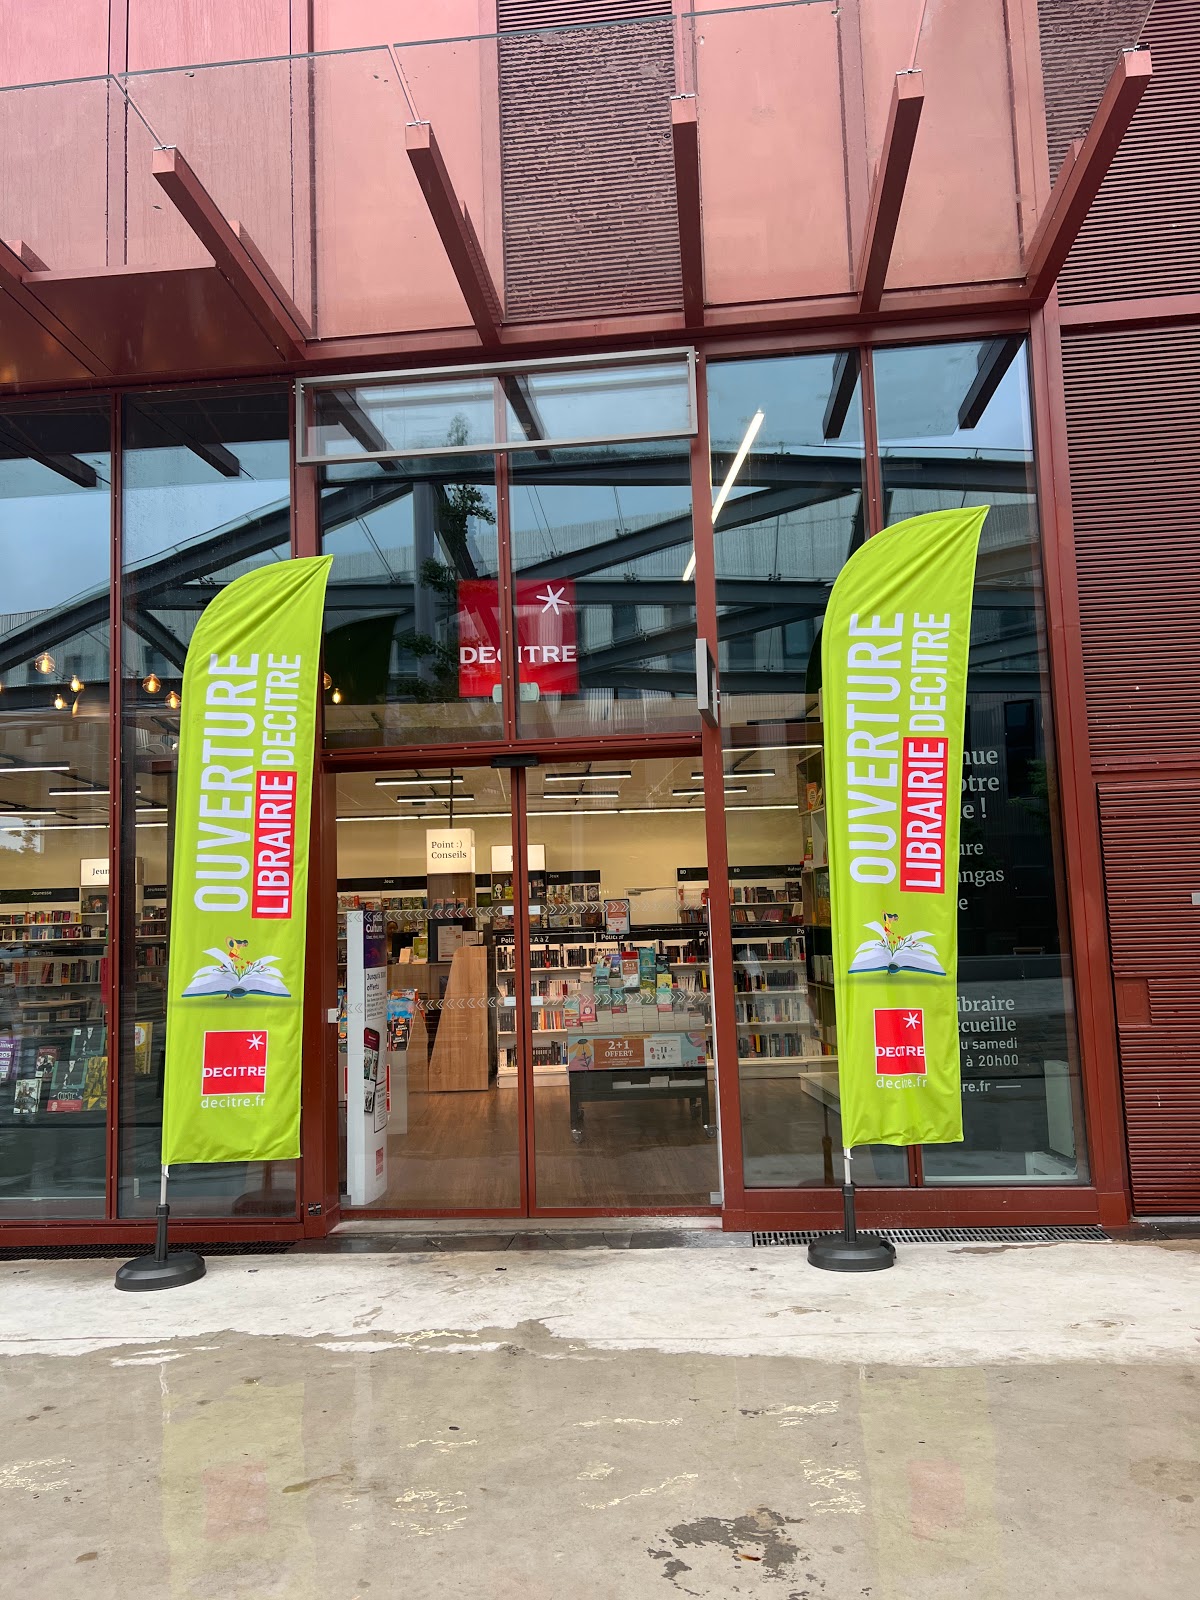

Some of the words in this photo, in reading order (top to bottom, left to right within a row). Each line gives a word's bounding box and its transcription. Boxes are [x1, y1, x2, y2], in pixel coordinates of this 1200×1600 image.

[460, 645, 576, 664] DEITRE
[909, 613, 950, 732] DECITRE
[261, 654, 301, 766] DECITRE
[847, 613, 904, 884] OUVERTURE
[962, 750, 998, 765] nue
[194, 654, 259, 912] OUVERTURE
[961, 775, 999, 791] otre
[906, 742, 944, 888] LIBRAIRIE
[256, 775, 293, 914] LIBRAIRIE
[431, 840, 453, 849] Point
[431, 850, 467, 859] Conseils
[92, 867, 109, 876] Jeun
[957, 995, 1015, 1012] ibraire
[608, 1040, 630, 1050] 2+1
[972, 1037, 1018, 1050] samedi
[604, 1049, 634, 1058] OFFERT
[966, 1054, 973, 1067] à
[978, 1054, 1019, 1067] 20h00
[202, 1066, 266, 1078] DECITRE
[962, 1080, 991, 1093] re.fr
[200, 1095, 266, 1109] decitre.fr
